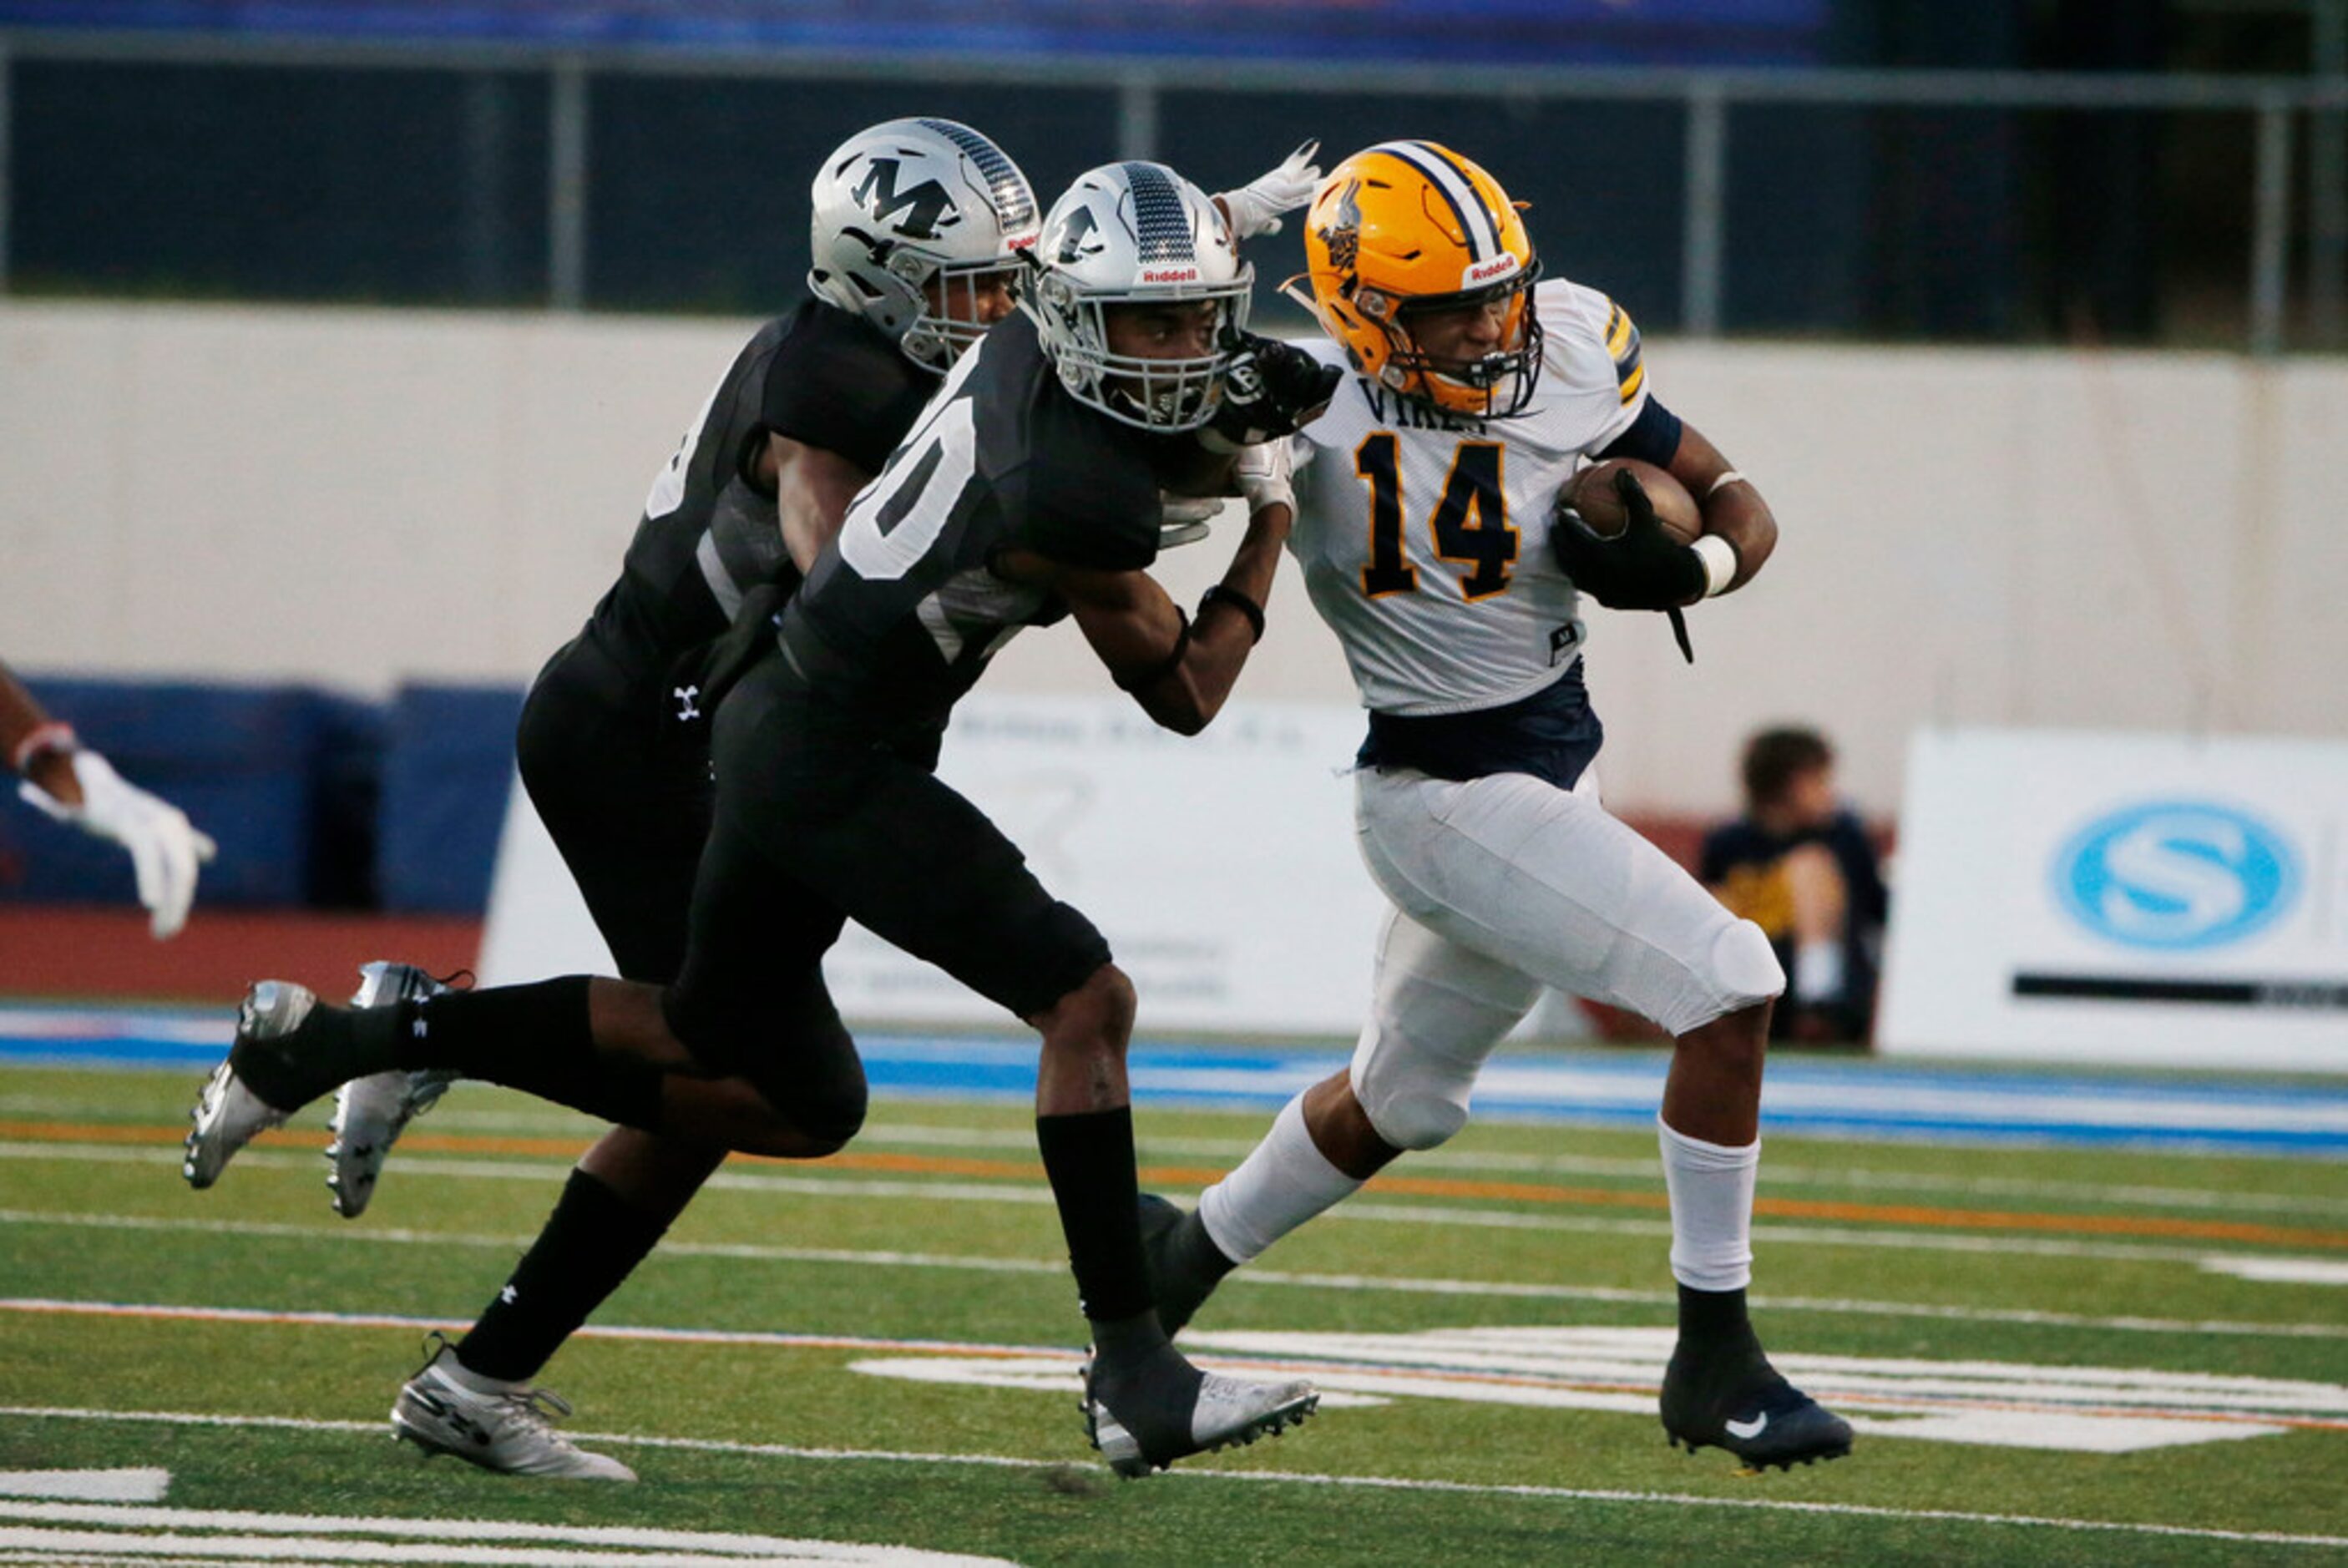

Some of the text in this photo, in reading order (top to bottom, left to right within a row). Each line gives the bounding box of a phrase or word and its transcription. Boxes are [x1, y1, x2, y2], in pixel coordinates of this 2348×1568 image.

[851, 158, 957, 240] M
[1143, 268, 1196, 282] Riddell
[1358, 377, 1487, 435] VIK
[838, 333, 989, 577] 0
[1356, 430, 1521, 603] 14
